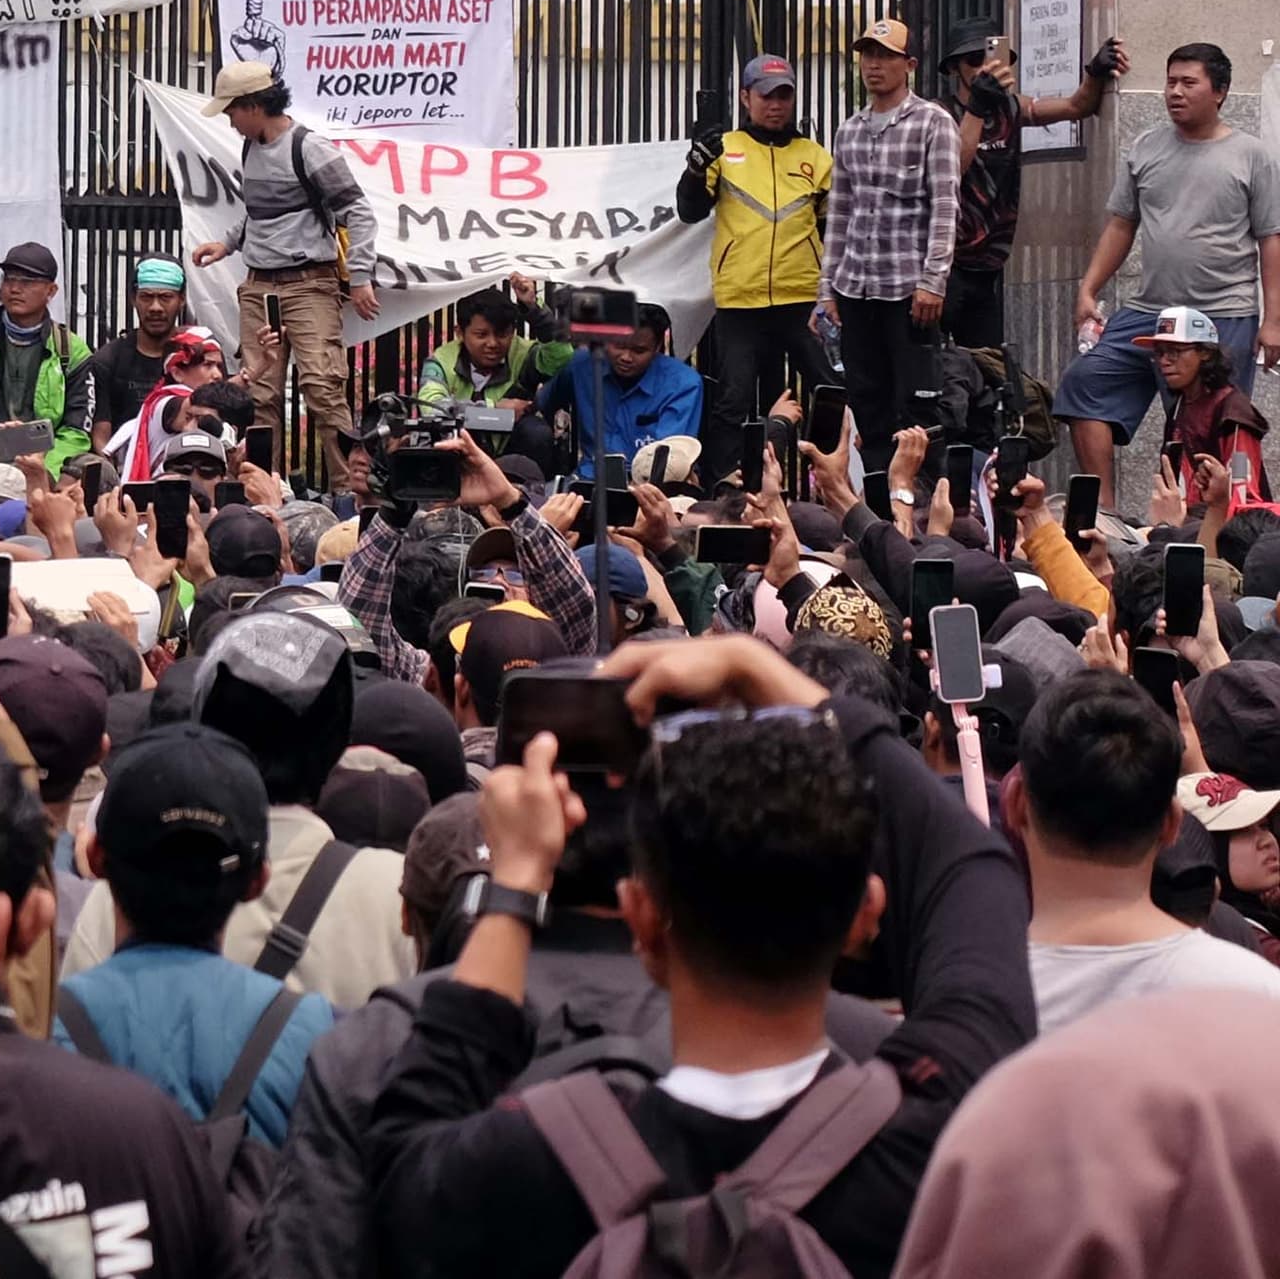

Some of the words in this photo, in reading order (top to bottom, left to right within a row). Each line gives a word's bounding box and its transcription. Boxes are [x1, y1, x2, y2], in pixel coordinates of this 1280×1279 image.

[282, 0, 307, 26] UU
[371, 28, 402, 40] DAN
[306, 43, 395, 71] HUKUM
[403, 42, 467, 69] MATI
[316, 71, 458, 97] KORUPTOR
[326, 106, 348, 122] iki
[351, 105, 413, 125] jeporo
